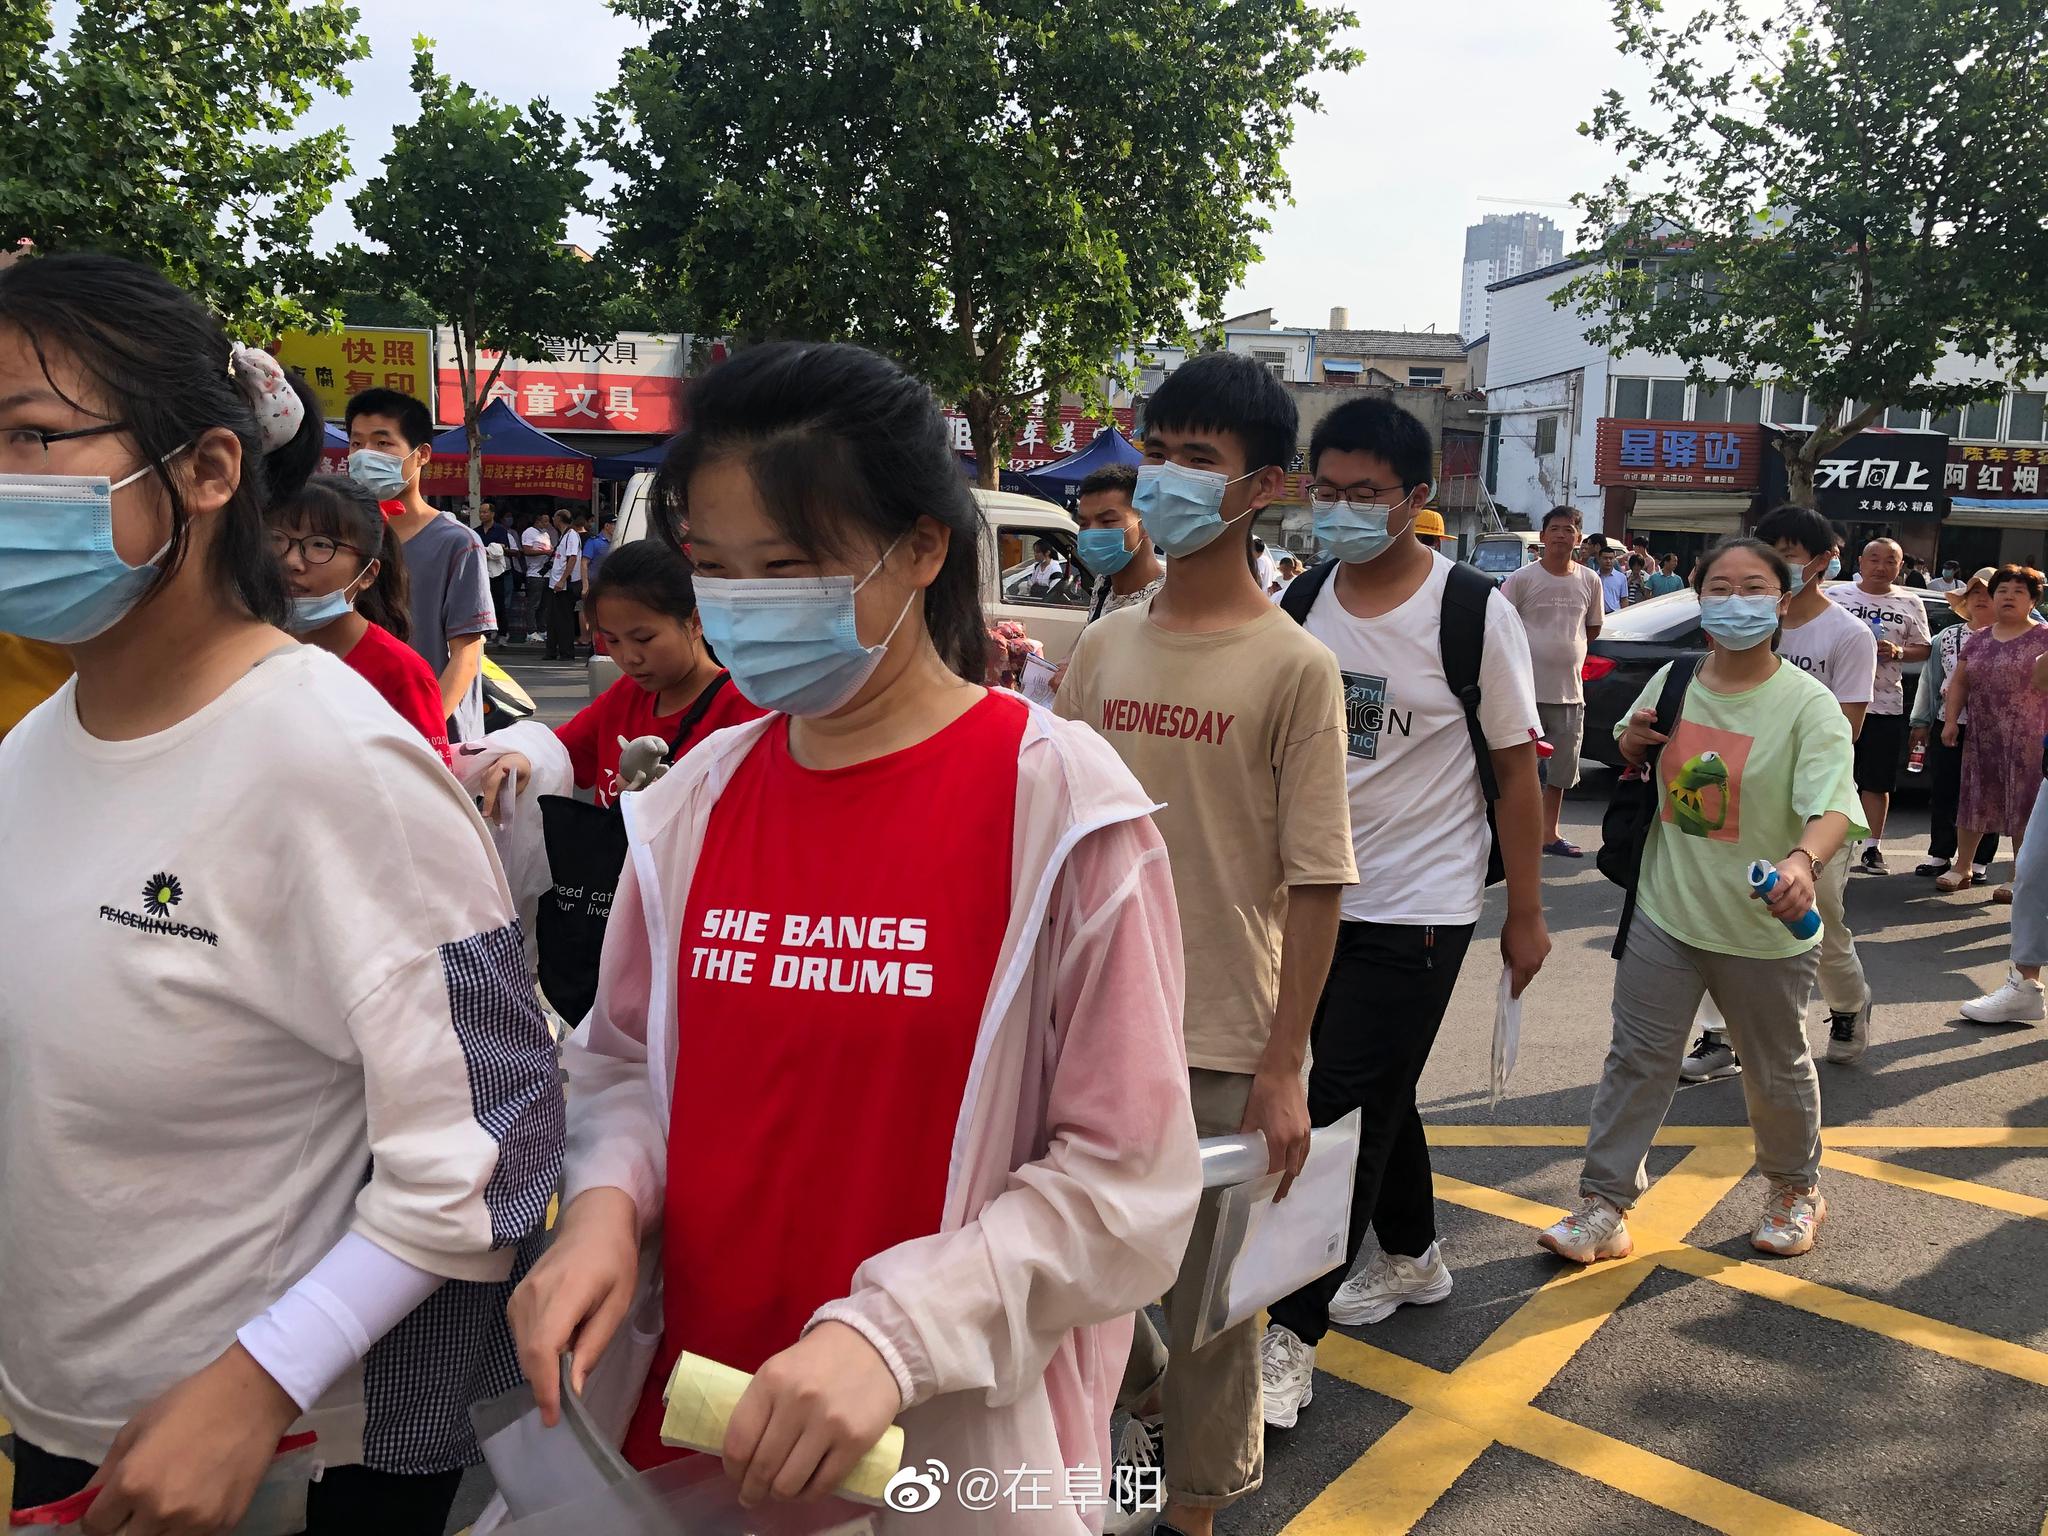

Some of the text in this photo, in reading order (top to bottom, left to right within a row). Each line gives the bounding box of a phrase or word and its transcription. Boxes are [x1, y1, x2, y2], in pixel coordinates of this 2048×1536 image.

[341, 337, 416, 366] 快照
[344, 370, 416, 395] 复印
[1619, 429, 1742, 470] 星驿站
[1102, 698, 1235, 745] WEDNESDAY
[1346, 700, 1413, 737] IGN
[700, 908, 927, 951] SHE BANGS
[690, 946, 934, 998] THE DRUMS
